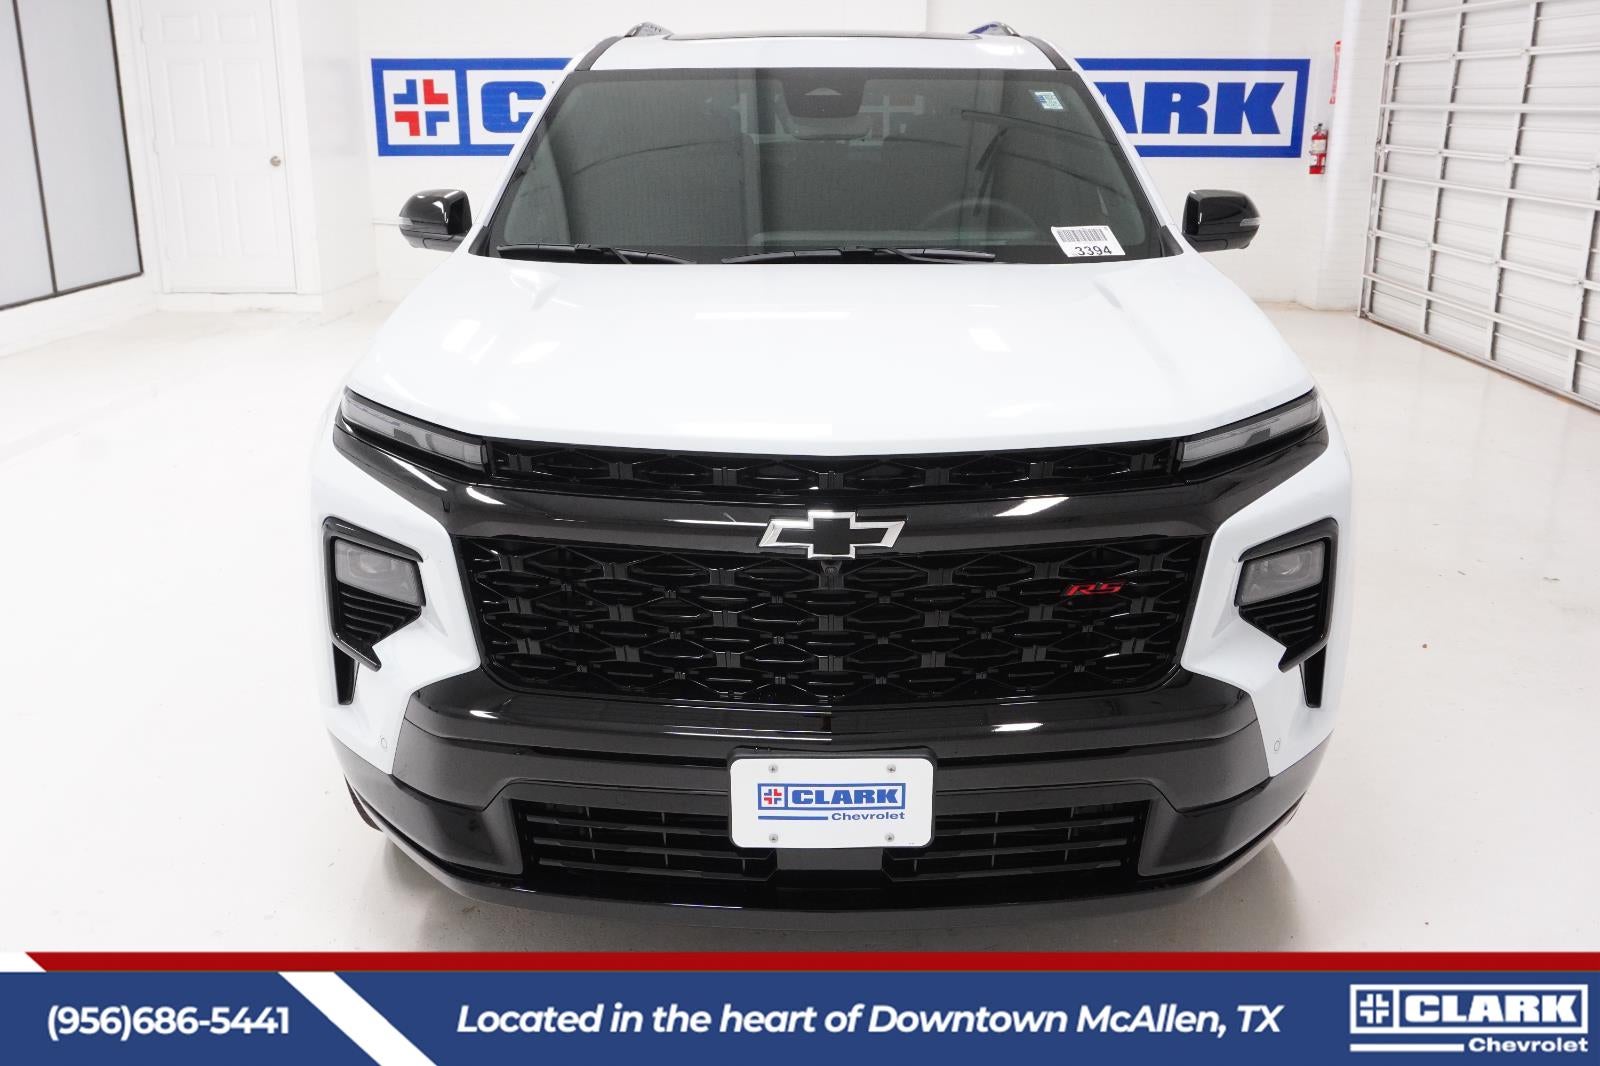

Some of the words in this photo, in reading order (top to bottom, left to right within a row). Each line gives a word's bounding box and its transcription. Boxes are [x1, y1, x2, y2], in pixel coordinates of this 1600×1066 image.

[481, 81, 547, 133] C
[1093, 82, 1284, 134] ARK
[1074, 245, 1112, 256] 3394
[1064, 582, 1122, 596] RS
[791, 788, 898, 805] CLARK
[831, 811, 905, 821] Chevrolet
